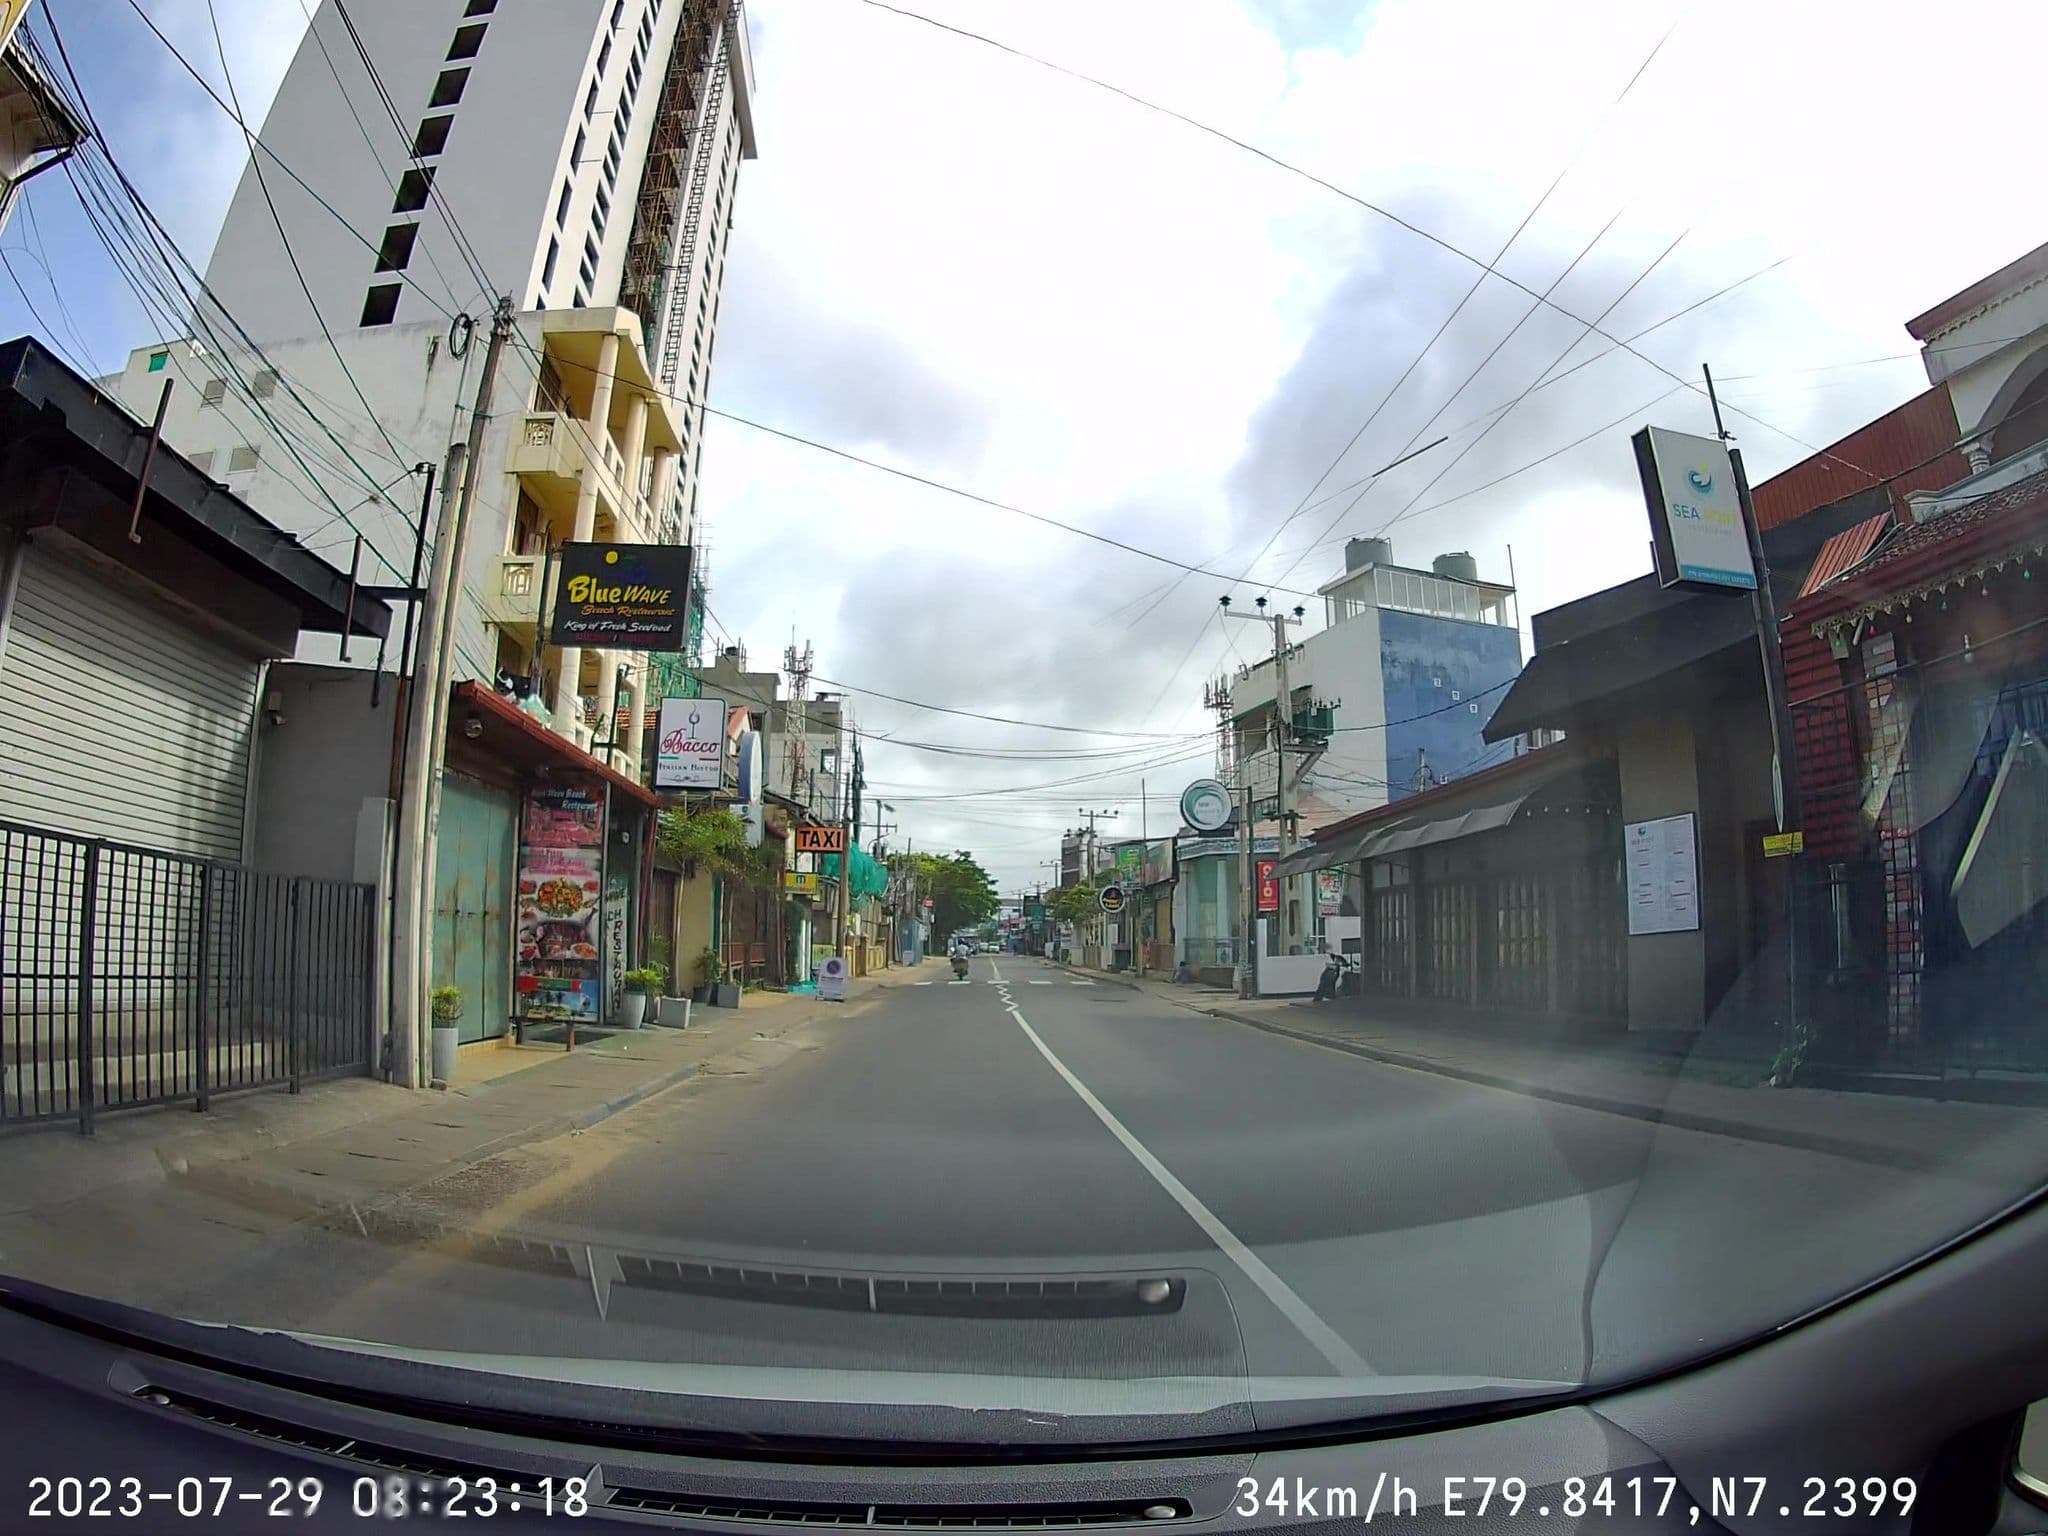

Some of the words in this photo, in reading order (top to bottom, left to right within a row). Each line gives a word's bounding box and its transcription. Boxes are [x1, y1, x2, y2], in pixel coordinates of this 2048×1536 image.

[1672, 503, 1701, 521] SEA
[567, 575, 622, 604] Blue
[563, 620, 588, 632] King
[600, 621, 627, 632] Fresh
[628, 622, 673, 633] Seafood
[660, 727, 721, 755] Bacco
[800, 830, 842, 849] TAXI
